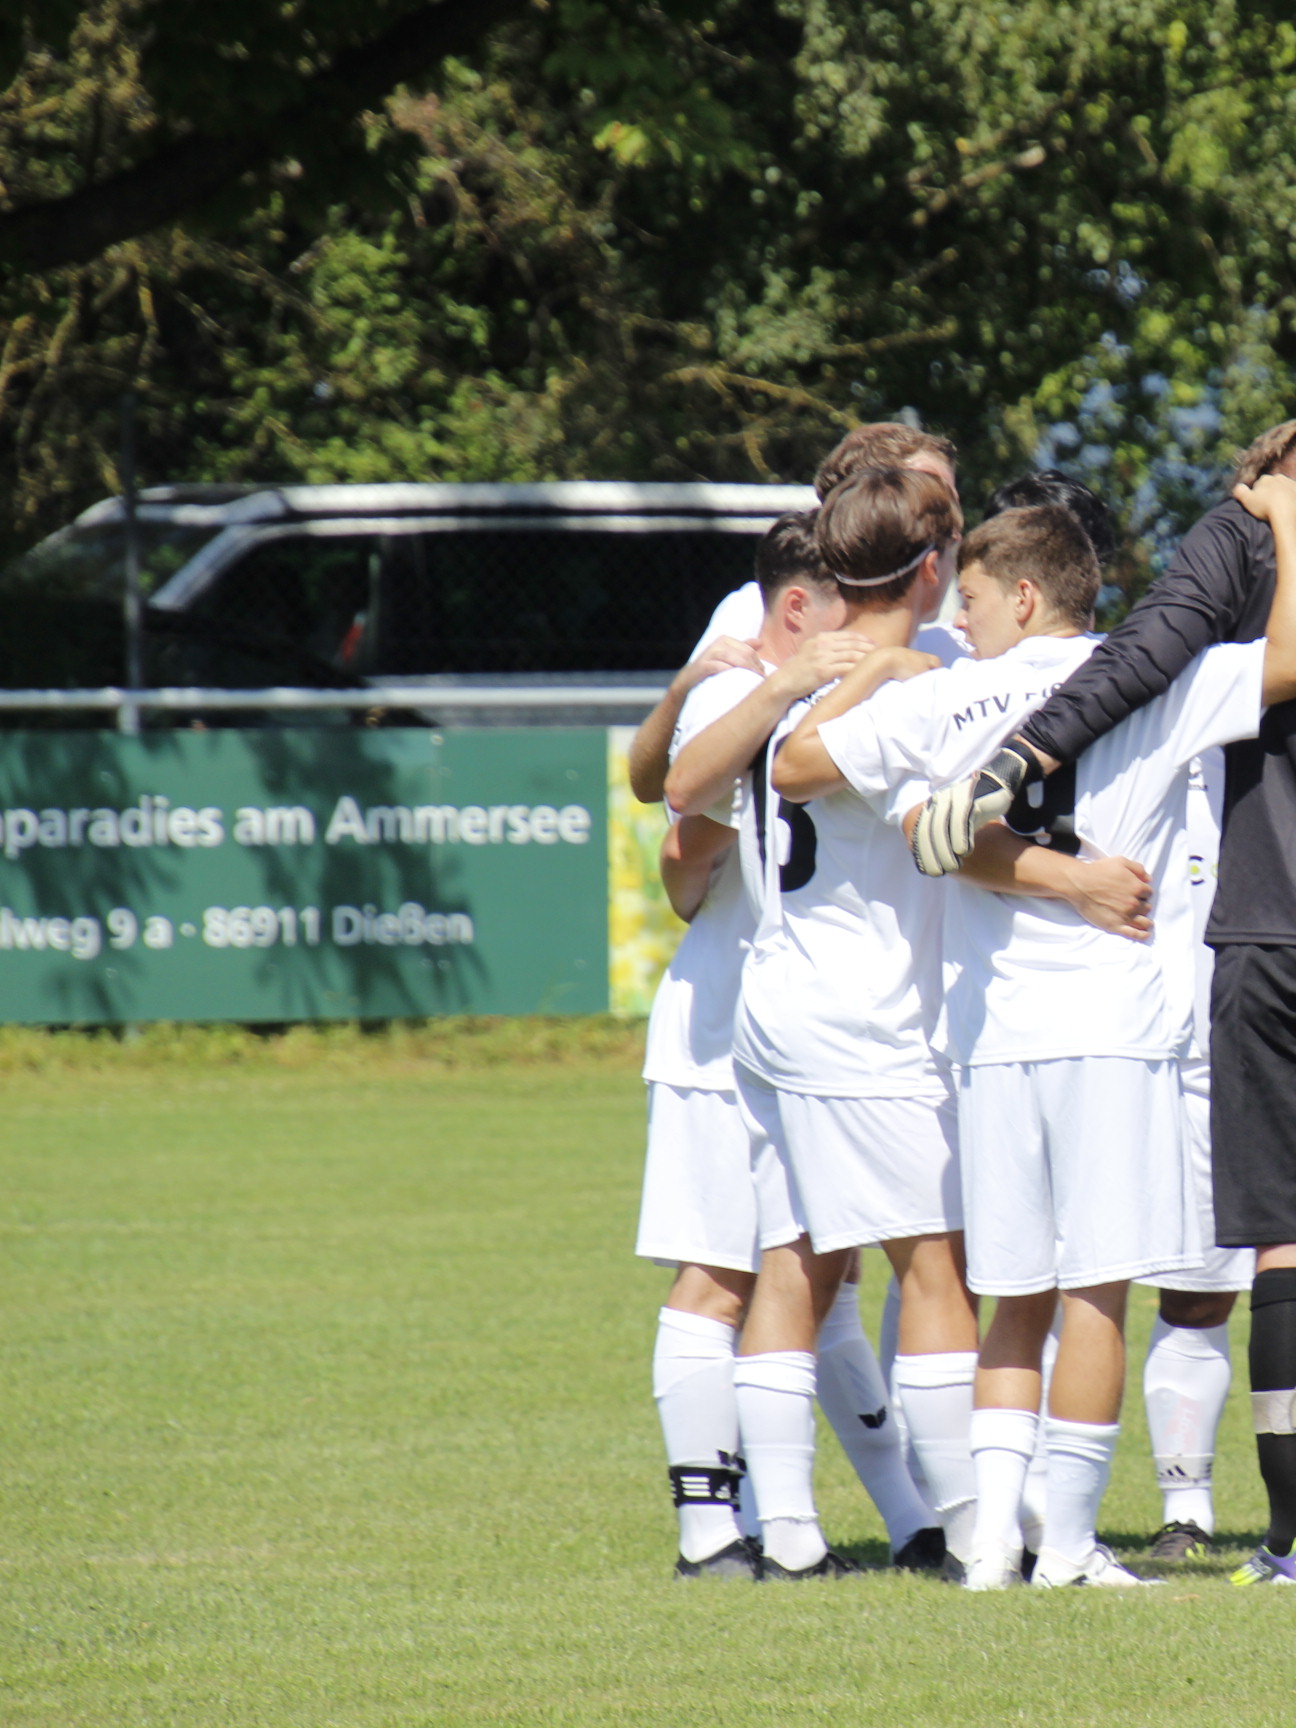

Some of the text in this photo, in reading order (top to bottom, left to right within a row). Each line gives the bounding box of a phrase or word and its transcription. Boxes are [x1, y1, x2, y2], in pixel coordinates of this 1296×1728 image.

[953, 692, 1011, 731] MTV
[0, 794, 592, 860] paradies am Ammersee
[106, 907, 138, 950] 9
[143, 916, 173, 949] a
[202, 905, 321, 948] 86911
[332, 902, 474, 947] Dießen
